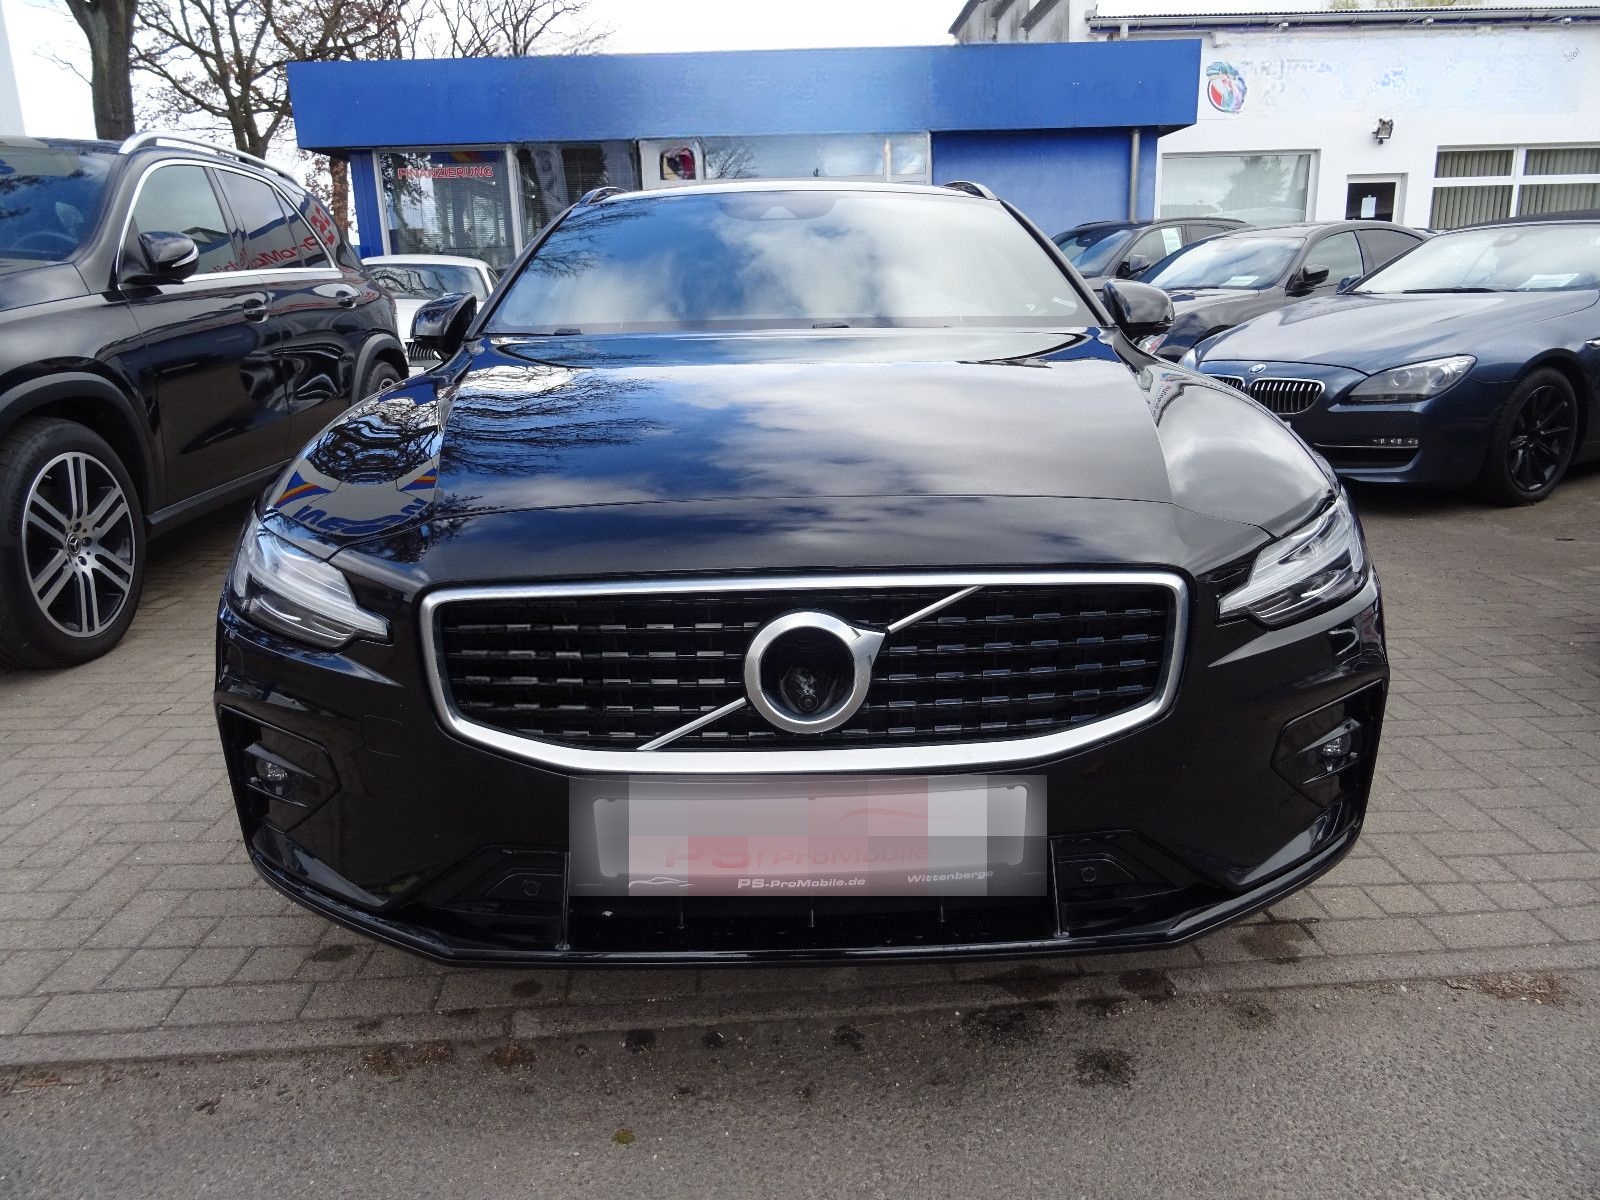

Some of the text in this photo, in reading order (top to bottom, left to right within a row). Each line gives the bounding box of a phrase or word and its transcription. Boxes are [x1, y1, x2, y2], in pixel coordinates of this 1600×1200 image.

[397, 166, 493, 179] FINANZIERUNG
[737, 877, 866, 889] PS-ProMobile.de
[907, 870, 994, 883] Wittenberge
